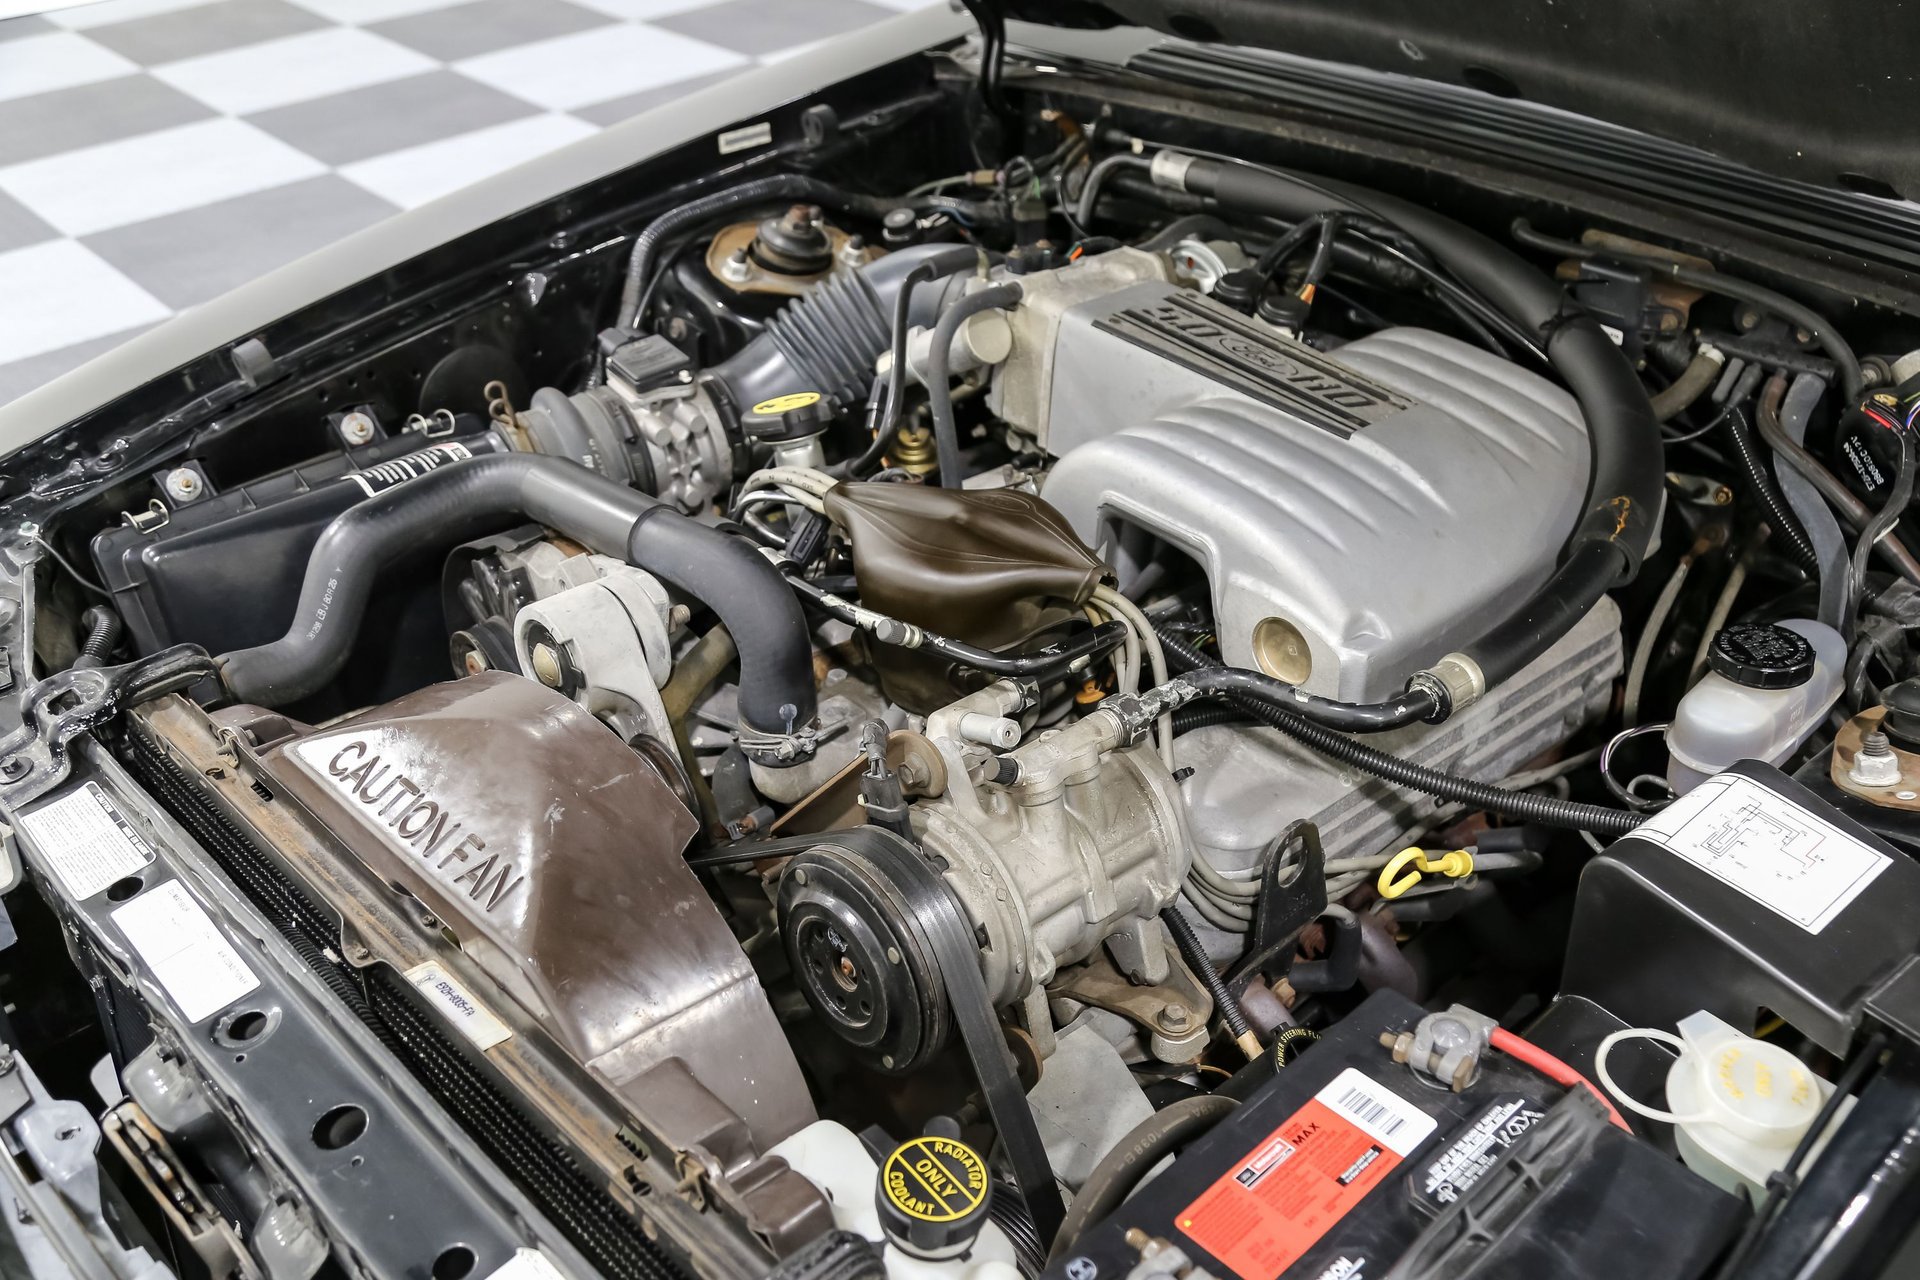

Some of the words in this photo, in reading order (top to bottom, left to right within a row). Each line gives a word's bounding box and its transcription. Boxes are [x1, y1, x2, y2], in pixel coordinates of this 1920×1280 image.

[328, 740, 462, 858] CAUTION
[436, 833, 525, 912] FAN
[1277, 1042, 1285, 1067] POWER
[1280, 1028, 1307, 1043] STEERING
[1292, 1122, 1321, 1147] MAX
[915, 1158, 958, 1198] ONLY
[934, 1141, 982, 1190] RADIATOR
[889, 1171, 936, 1216] COOLANT
